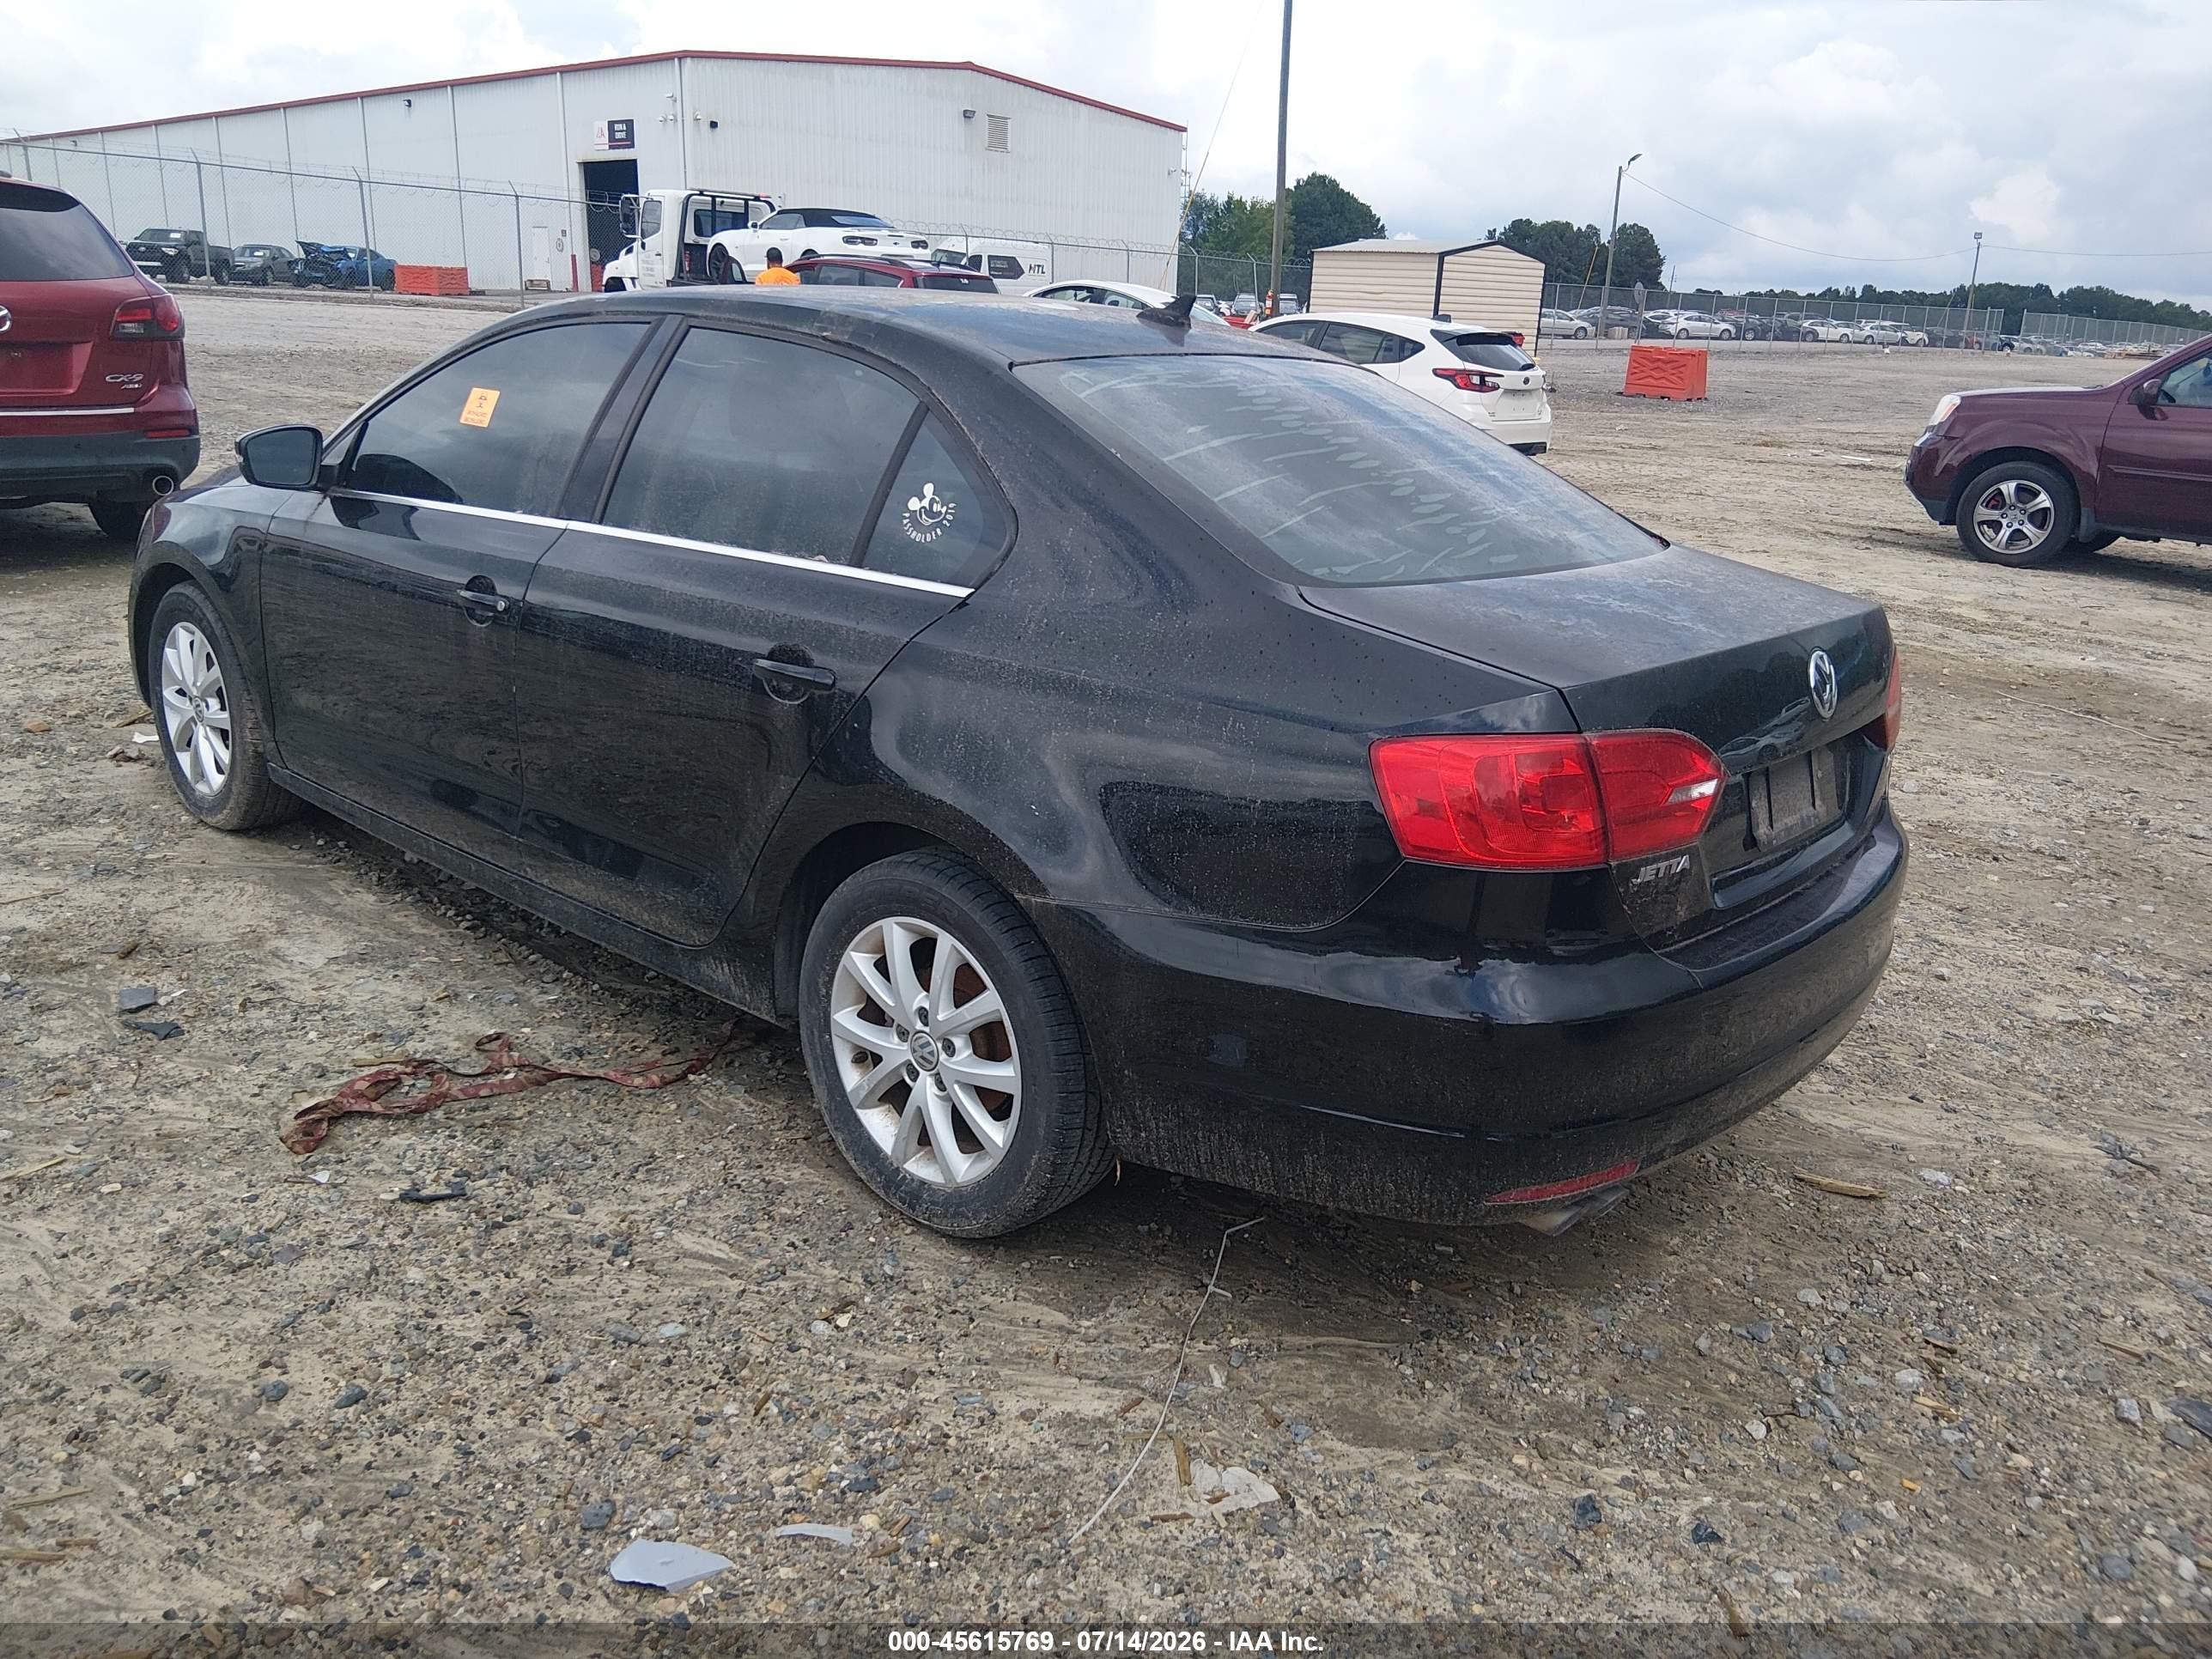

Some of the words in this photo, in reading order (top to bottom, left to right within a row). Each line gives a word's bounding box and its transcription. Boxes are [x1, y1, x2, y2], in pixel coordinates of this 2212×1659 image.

[902, 513, 943, 544] PASSHOLDER
[942, 502, 957, 528] 2019
[1631, 854, 1691, 885] JETTA
